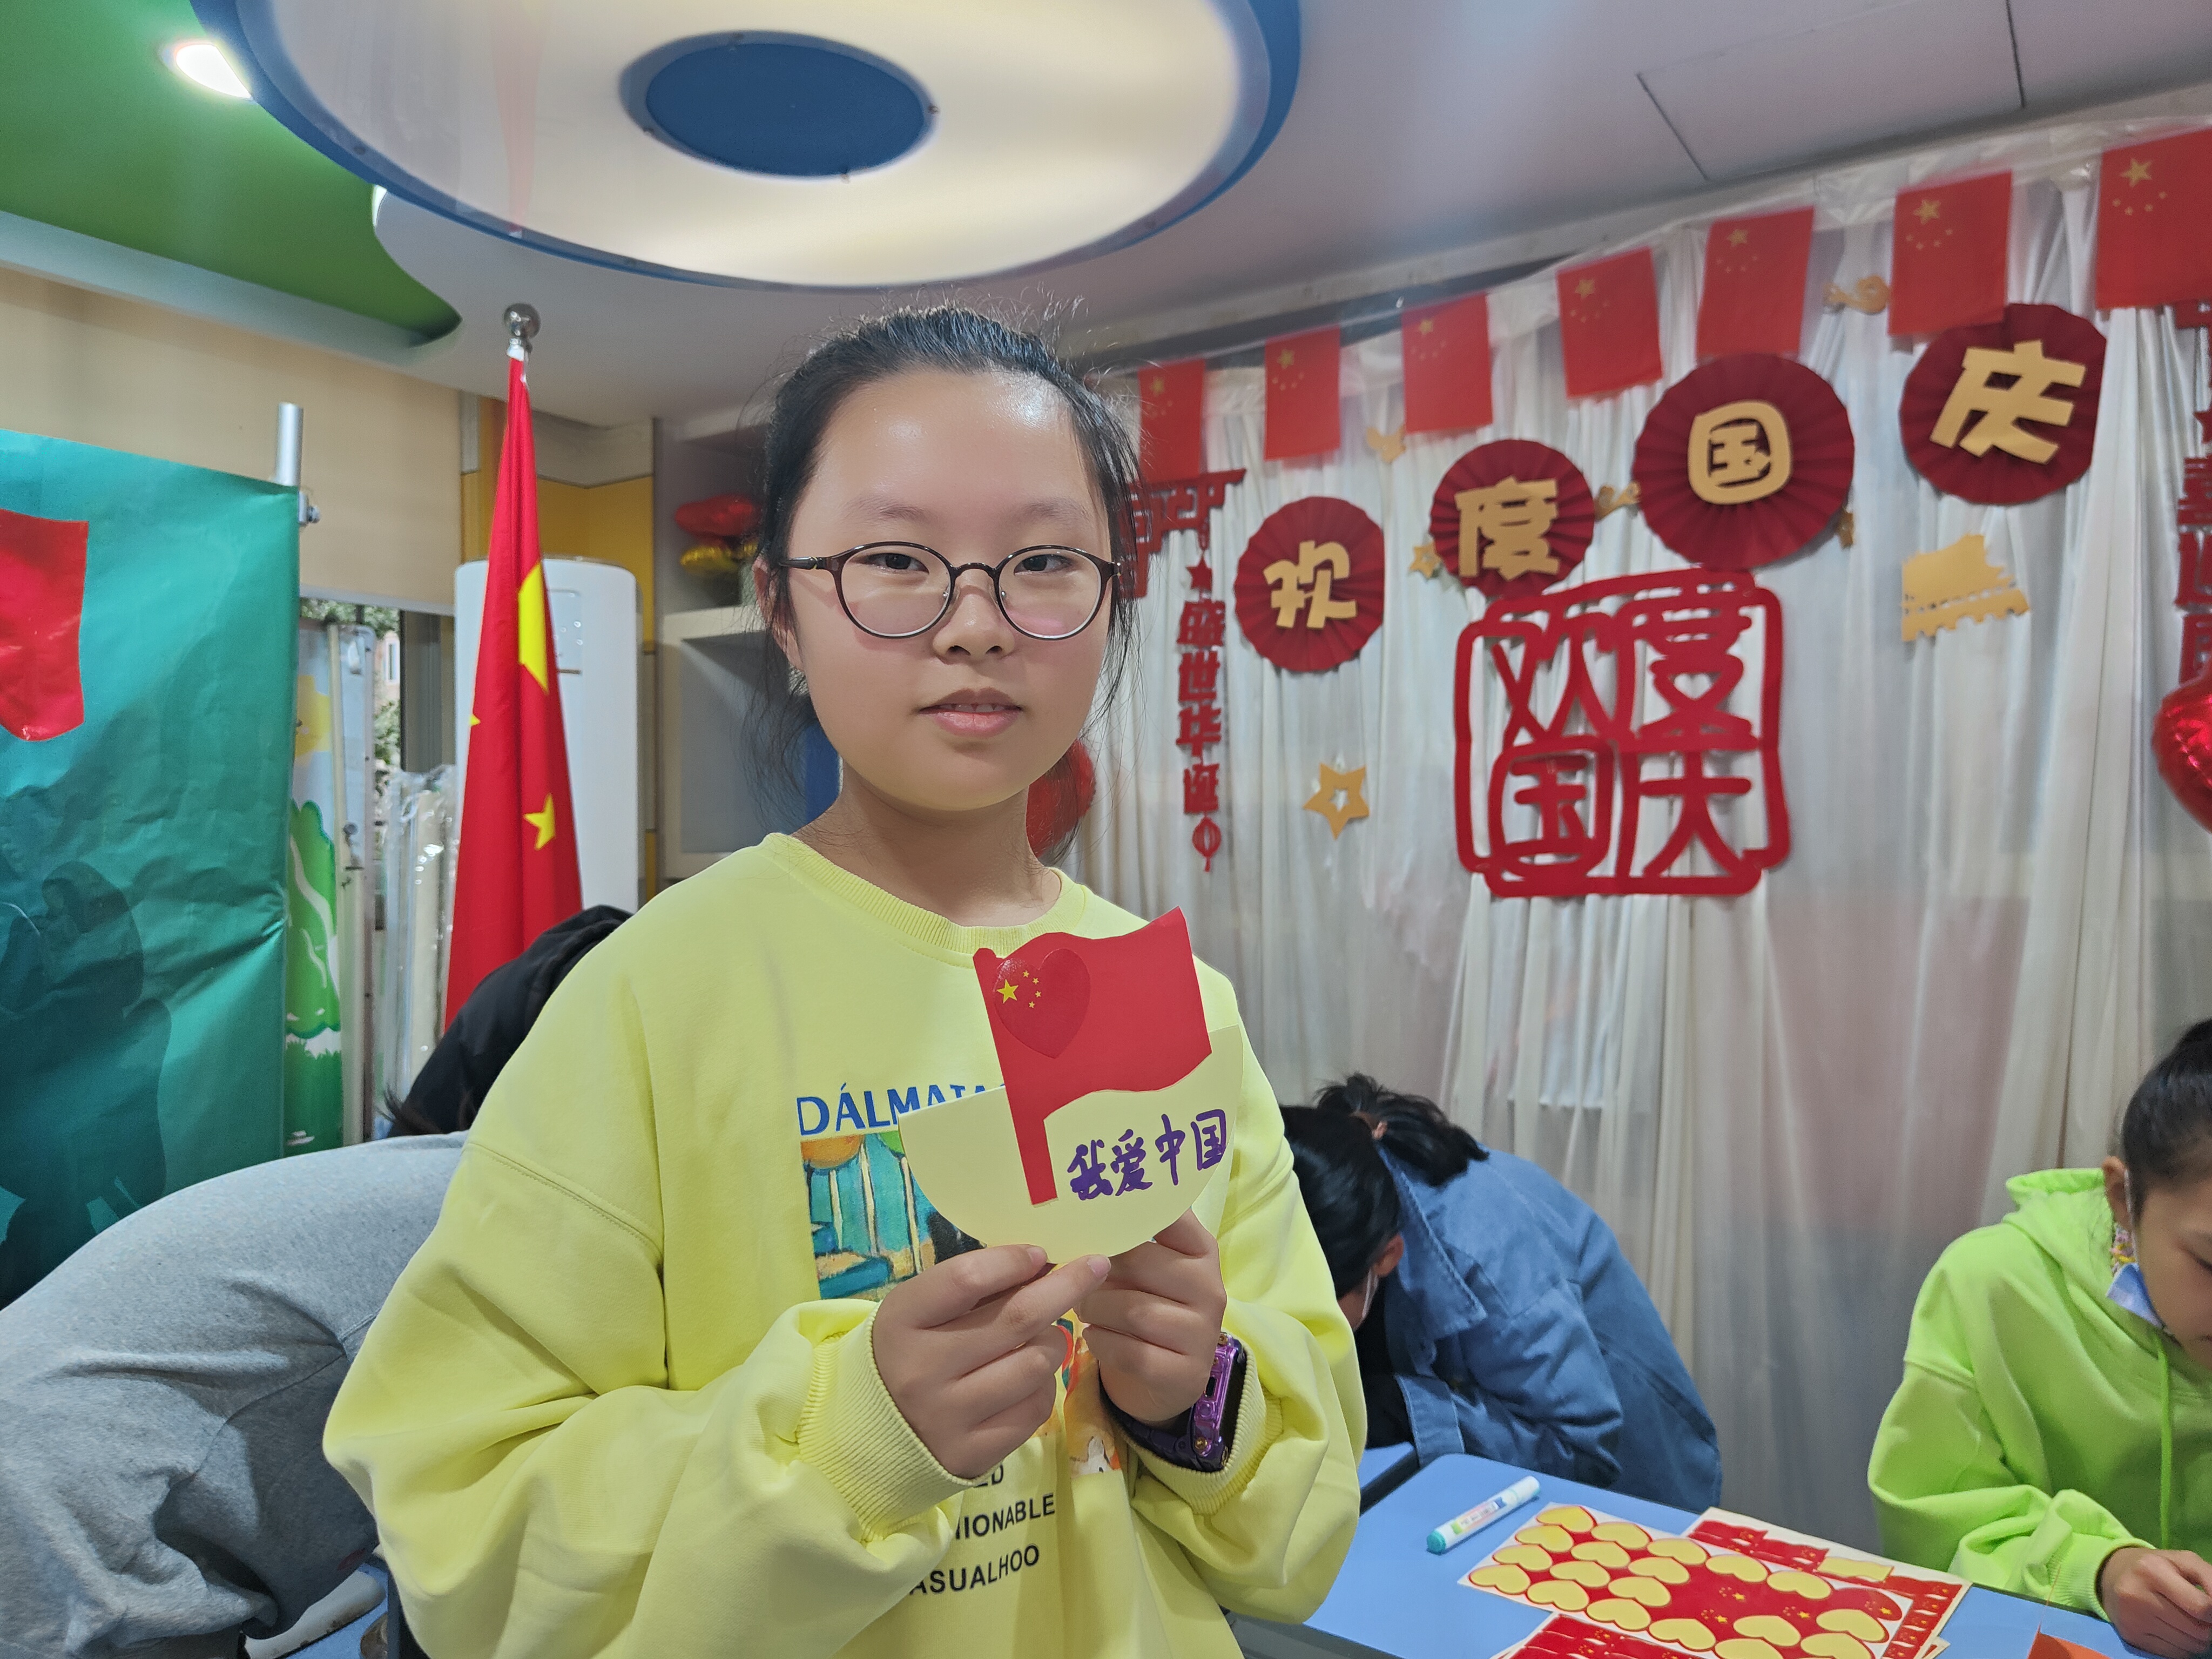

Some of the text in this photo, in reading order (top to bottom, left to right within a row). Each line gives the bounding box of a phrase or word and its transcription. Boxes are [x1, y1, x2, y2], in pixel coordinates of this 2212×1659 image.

[1263, 340, 2086, 629] 欢度国庆
[1067, 1109, 1226, 1201] 我爱中国
